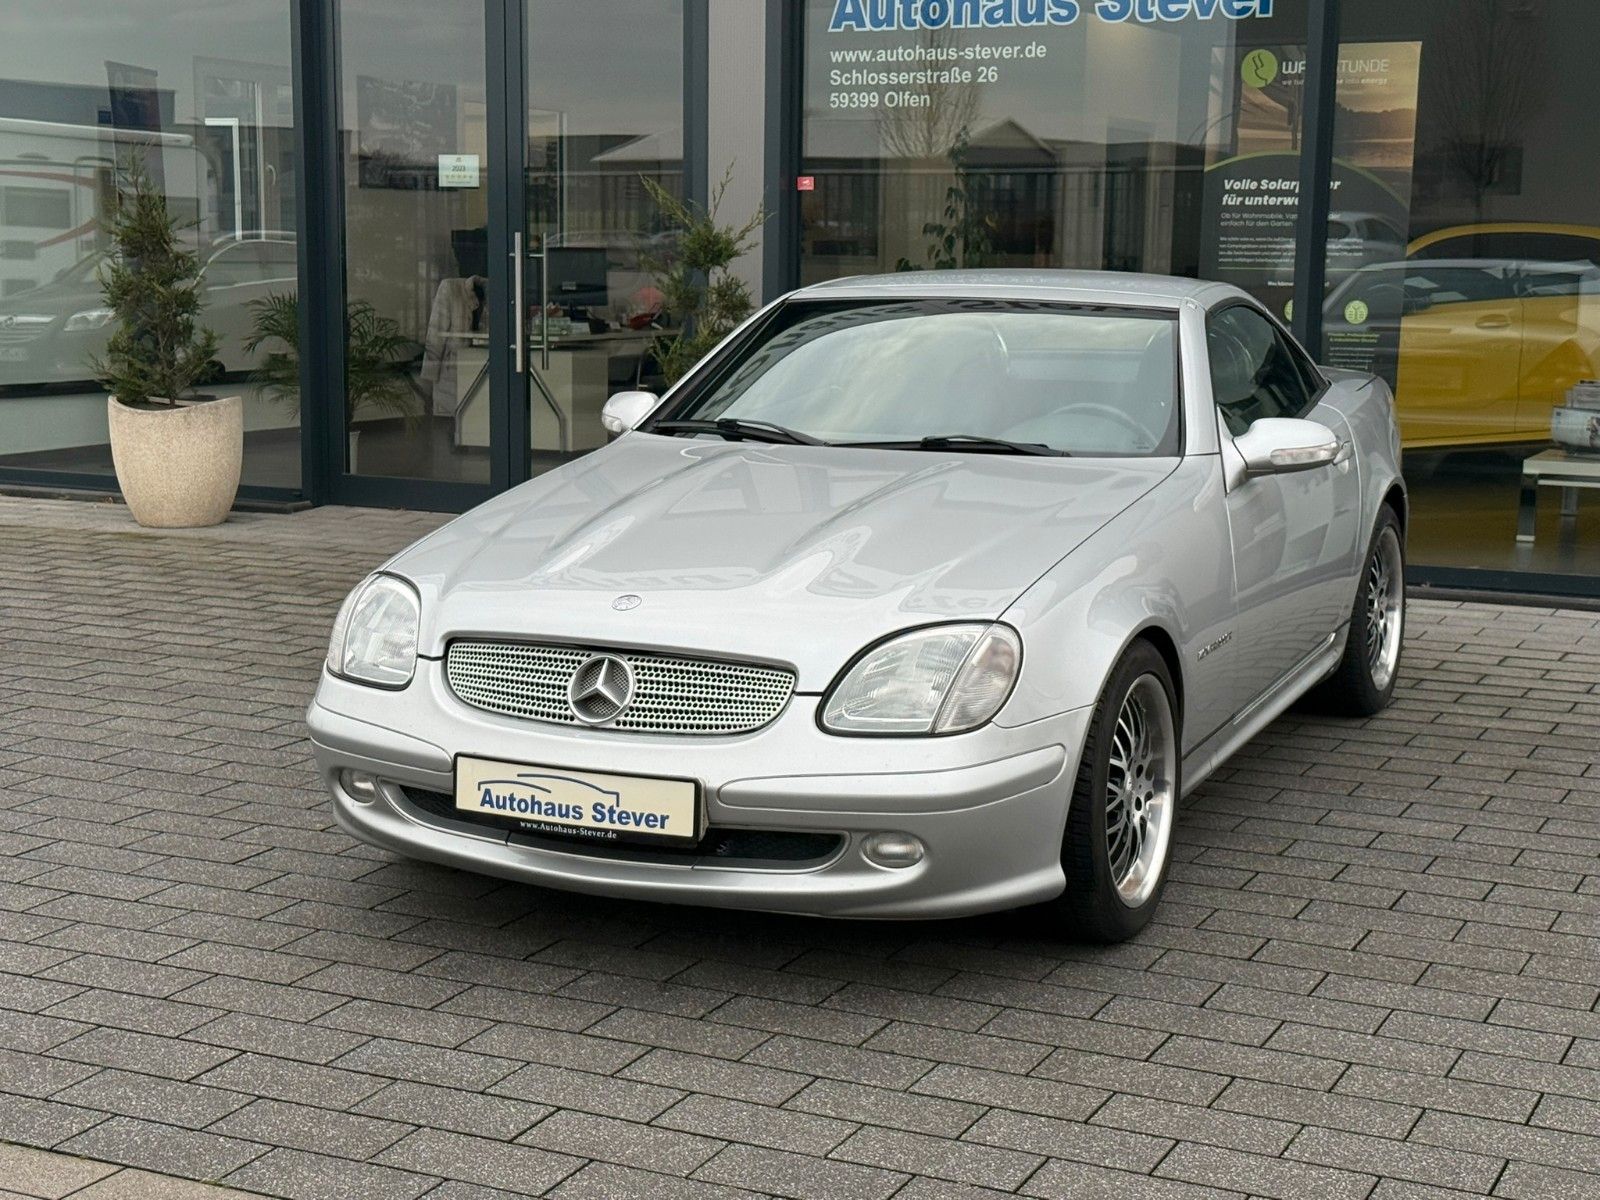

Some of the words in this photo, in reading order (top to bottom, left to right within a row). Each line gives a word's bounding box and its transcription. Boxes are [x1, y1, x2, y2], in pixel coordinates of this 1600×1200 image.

[830, 41, 1047, 63] www.autohaus-stever.de
[830, 66, 972, 86] Schlosserstraße
[976, 66, 999, 83] 26
[829, 92, 880, 109] 59399
[884, 91, 931, 108] Olfen
[1223, 178, 1259, 190] Volle
[1221, 193, 1244, 206] für
[480, 788, 584, 820] Autohaus
[591, 802, 670, 829] Stever
[519, 821, 617, 839] www.Autohaus-Stever.de
